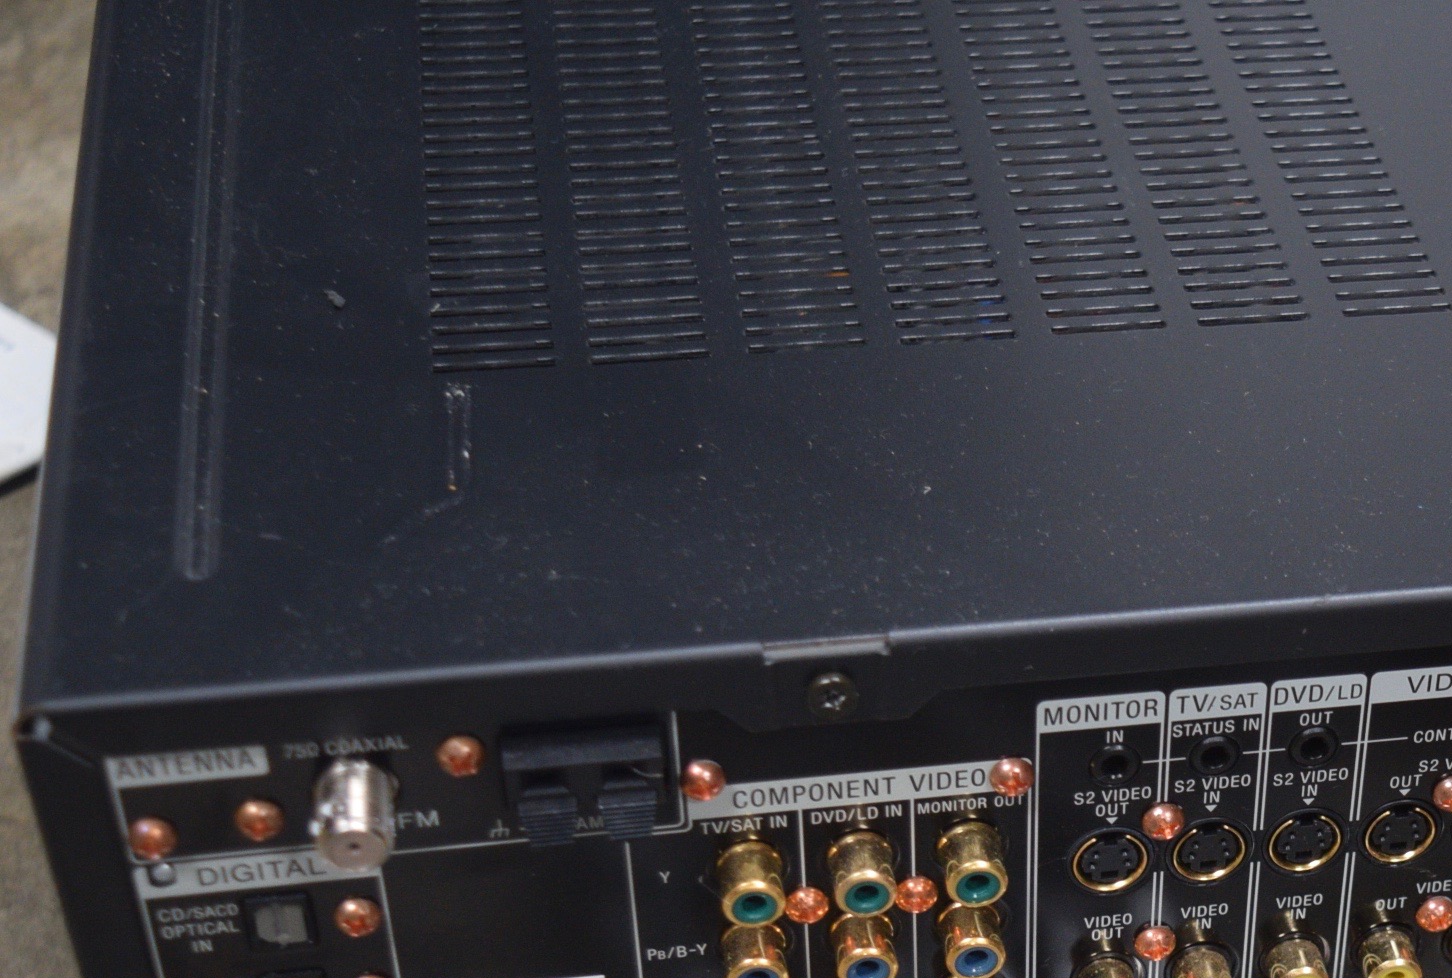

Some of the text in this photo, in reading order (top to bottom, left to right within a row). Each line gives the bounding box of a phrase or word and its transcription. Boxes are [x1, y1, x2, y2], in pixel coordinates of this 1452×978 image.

[1176, 692, 1260, 715] TV/SAT
[1274, 683, 1364, 707] DVD/LD
[1043, 699, 1159, 727] MONITOR
[1299, 711, 1334, 726] OUT
[1172, 717, 1260, 738] STATUS IN
[323, 735, 410, 756] COAXIAL
[1106, 730, 1125, 744] IN
[116, 754, 255, 781] ANTENNA
[1418, 758, 1440, 773] S2
[1174, 775, 1252, 793] S2 VIDEO
[1273, 768, 1350, 787] S2 VIDEO
[1389, 774, 1424, 789] OUT
[732, 767, 986, 809] COMPONENT VIDEO
[1073, 786, 1153, 806] S2 VIDEO
[1301, 784, 1319, 798] IN
[917, 792, 1025, 815] MONITOR OUT
[1203, 791, 1221, 804] IN
[397, 809, 440, 829] FM
[811, 804, 903, 826] DVD/LD IN
[1095, 803, 1130, 818] OUT
[701, 815, 789, 835] TV/SAT IN
[196, 857, 327, 887] DIGITAL
[659, 870, 671, 884] Y
[1276, 893, 1324, 910] VIDEO
[1375, 897, 1408, 911] OUT
[156, 904, 239, 922] CD/SACD
[1181, 903, 1229, 919] VIDEO
[1290, 907, 1307, 921] IN
[161, 920, 240, 940] OPTICAL
[1084, 913, 1133, 930] VIDEO
[1195, 917, 1213, 930] IN
[1091, 927, 1125, 941] OUT
[191, 939, 213, 954] IN
